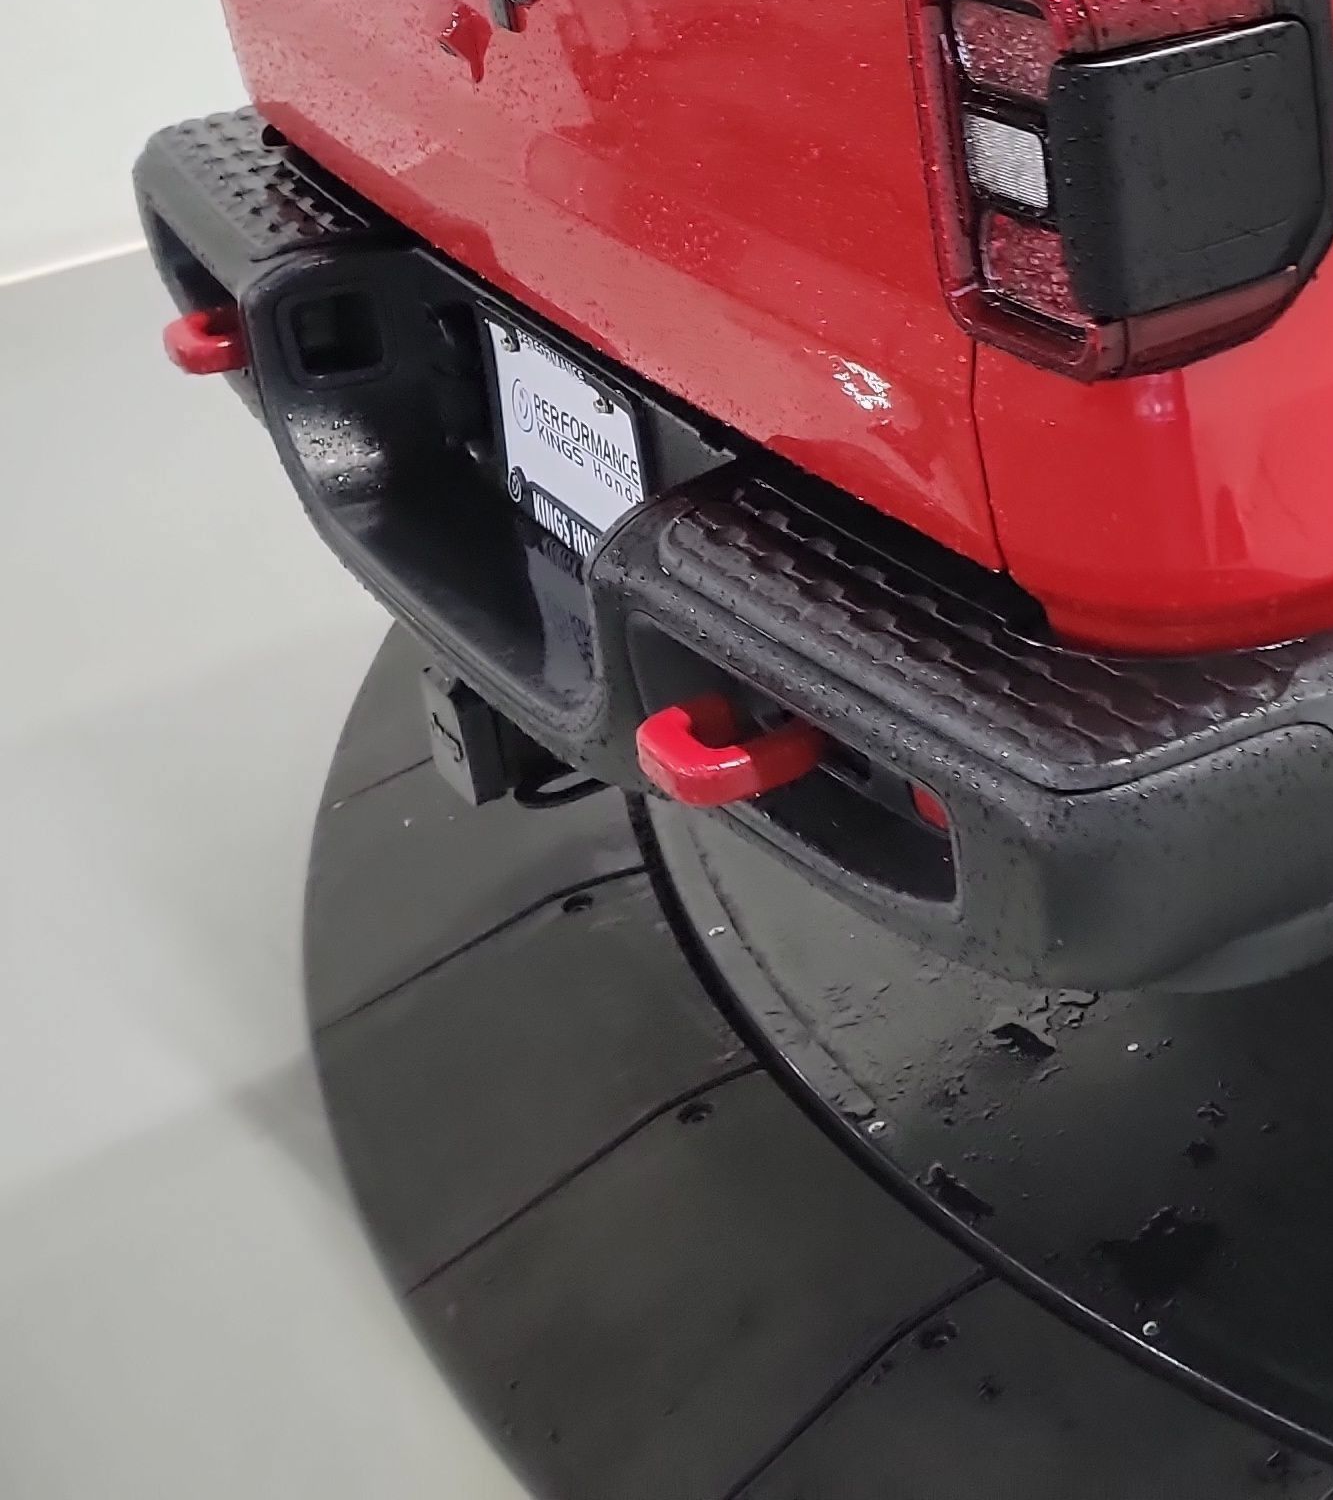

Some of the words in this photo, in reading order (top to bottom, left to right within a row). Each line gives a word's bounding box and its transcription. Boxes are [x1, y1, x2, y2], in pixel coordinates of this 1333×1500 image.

[533, 393, 639, 485] PERFORMANCE
[536, 421, 584, 467] KINGS
[532, 490, 571, 549] KINGS
